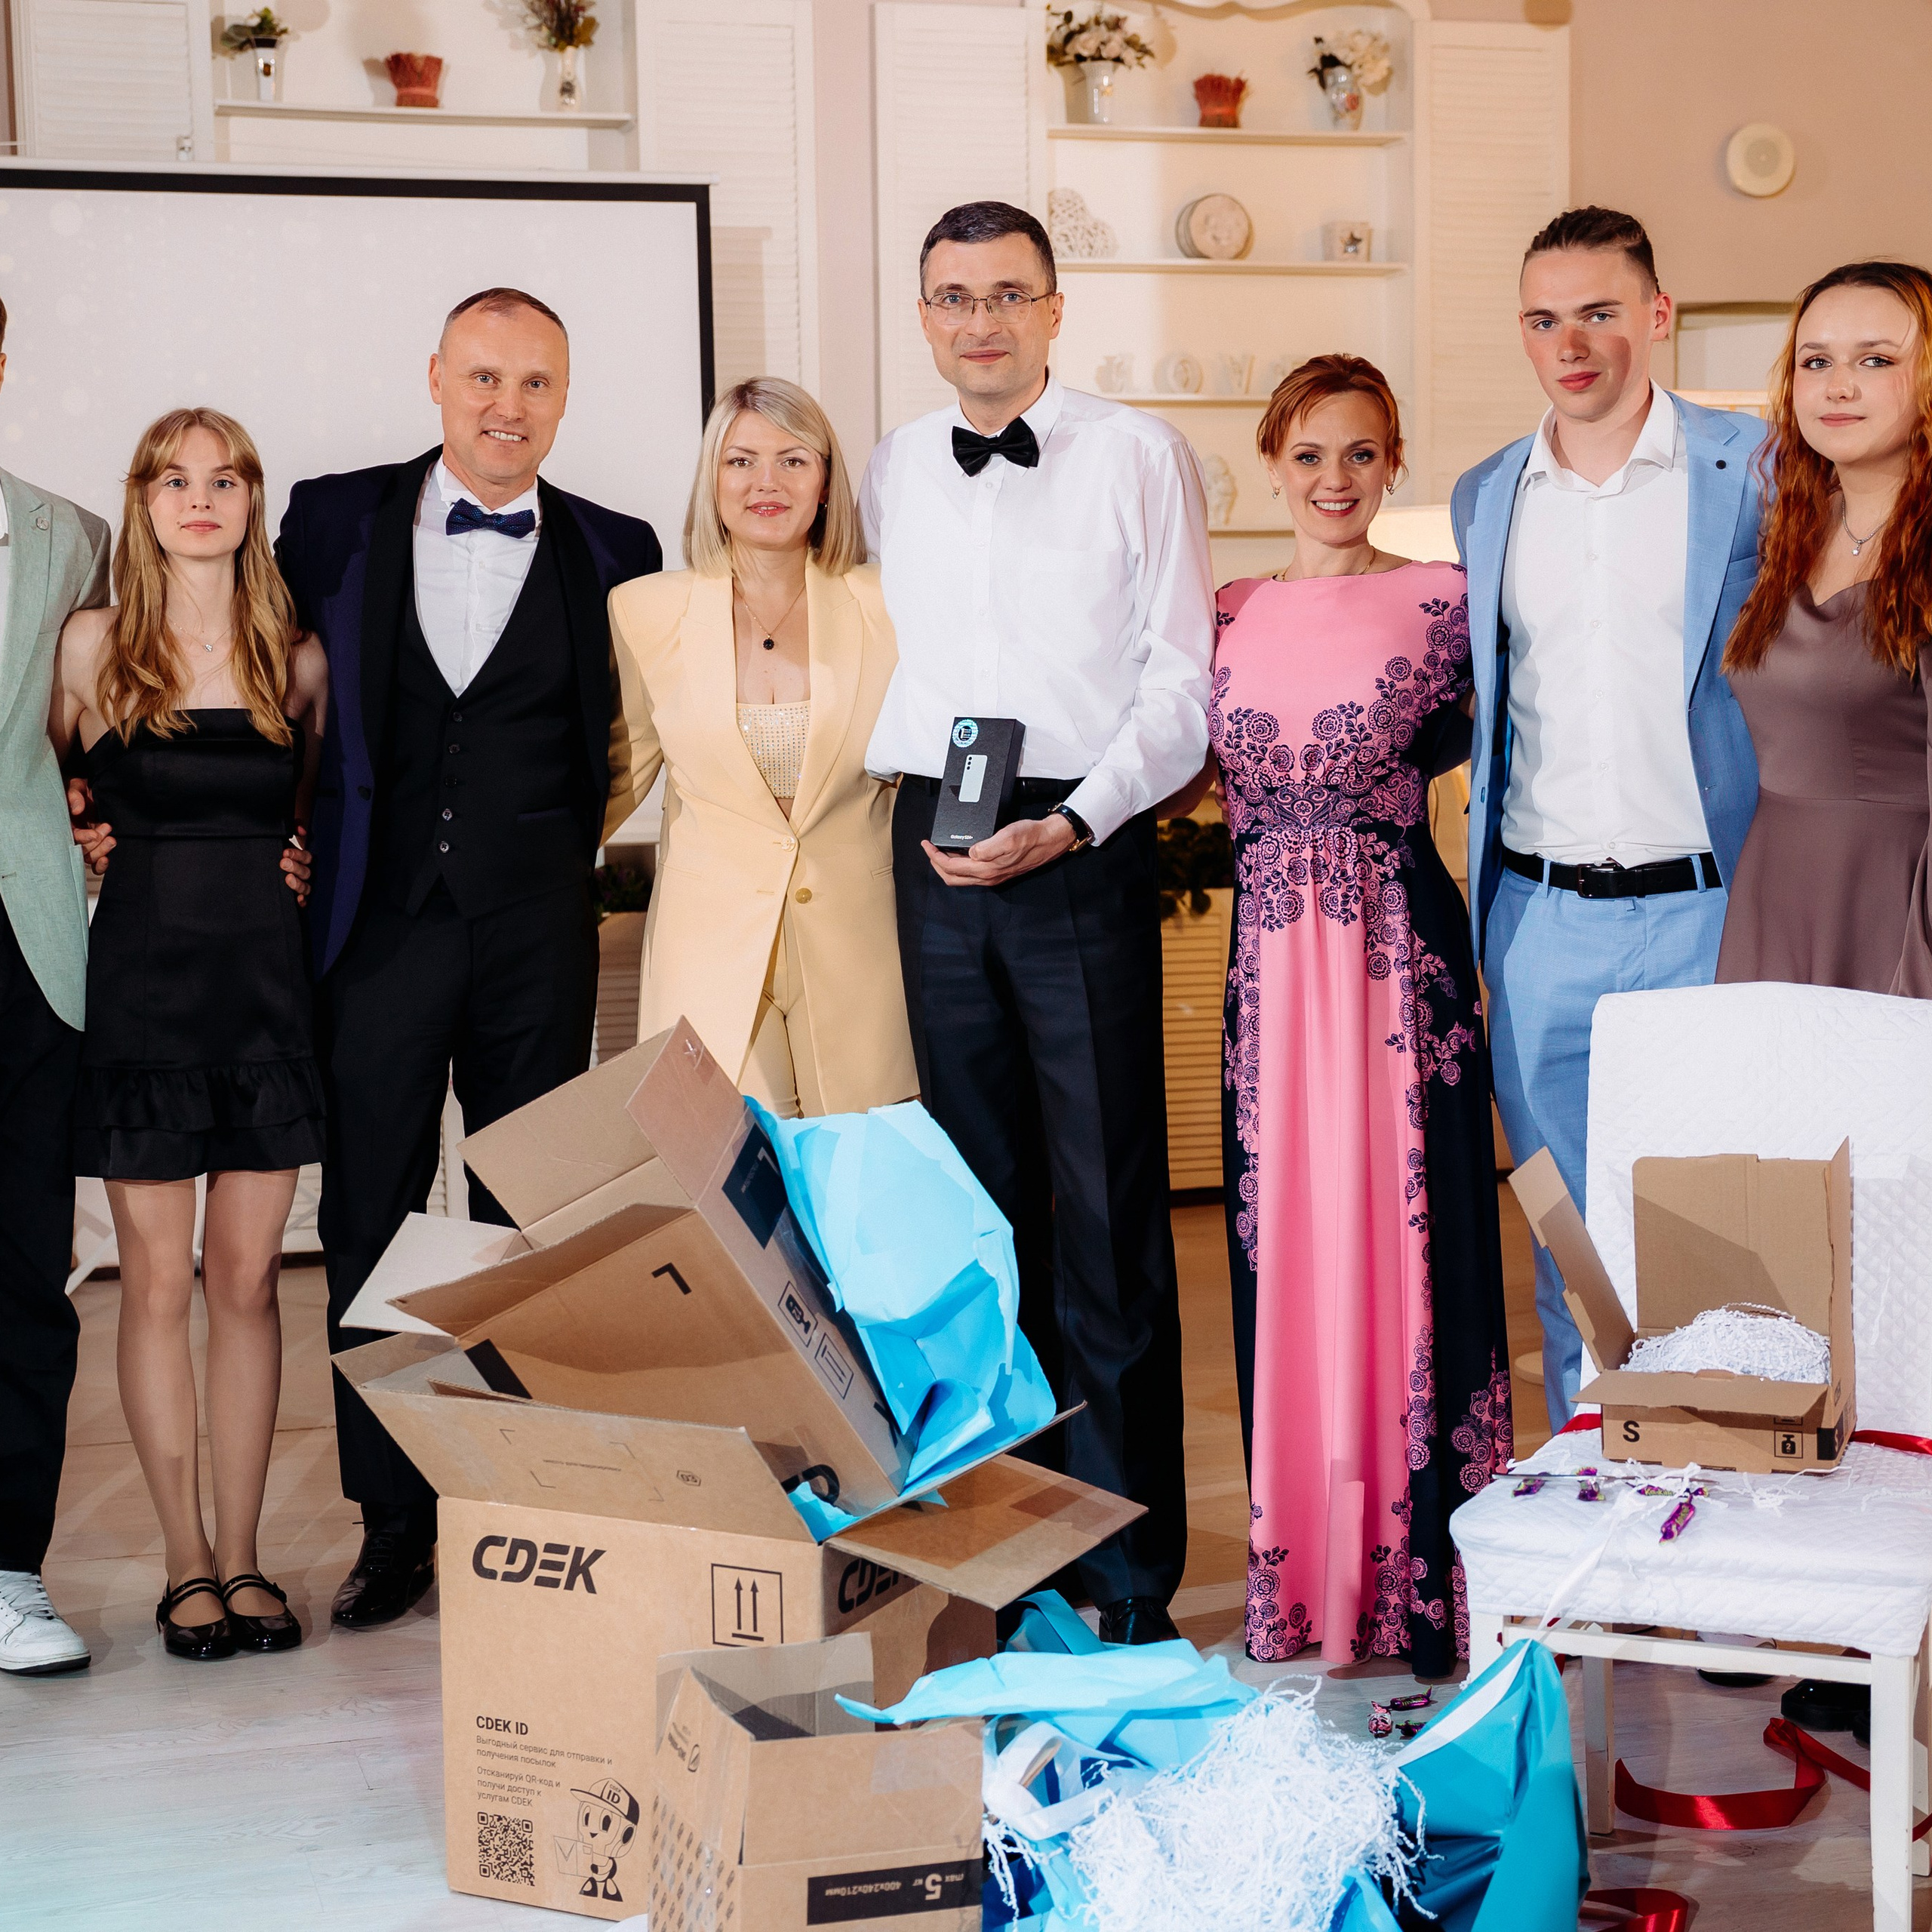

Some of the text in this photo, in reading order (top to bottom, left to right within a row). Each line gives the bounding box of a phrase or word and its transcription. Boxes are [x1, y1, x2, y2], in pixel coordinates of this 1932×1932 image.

[1623, 1420, 1641, 1442] S
[472, 1535, 607, 1595] CDEK
[476, 1715, 528, 1735] CDEK ID
[476, 1735, 518, 1749] Выгодный
[519, 1743, 548, 1755] сервис
[549, 1749, 565, 1758] для
[567, 1752, 605, 1764] отправки
[476, 1749, 556, 1768] получения посылок
[477, 1766, 524, 1782] Отсканируй
[525, 1774, 554, 1788] QR-код
[477, 1780, 506, 1791] получи
[506, 1785, 535, 1797] доступ
[607, 1789, 621, 1804] ID
[477, 1792, 534, 1807] услугам CDEK
[912, 1878, 924, 1887] кг
[924, 1873, 943, 1901] 5
